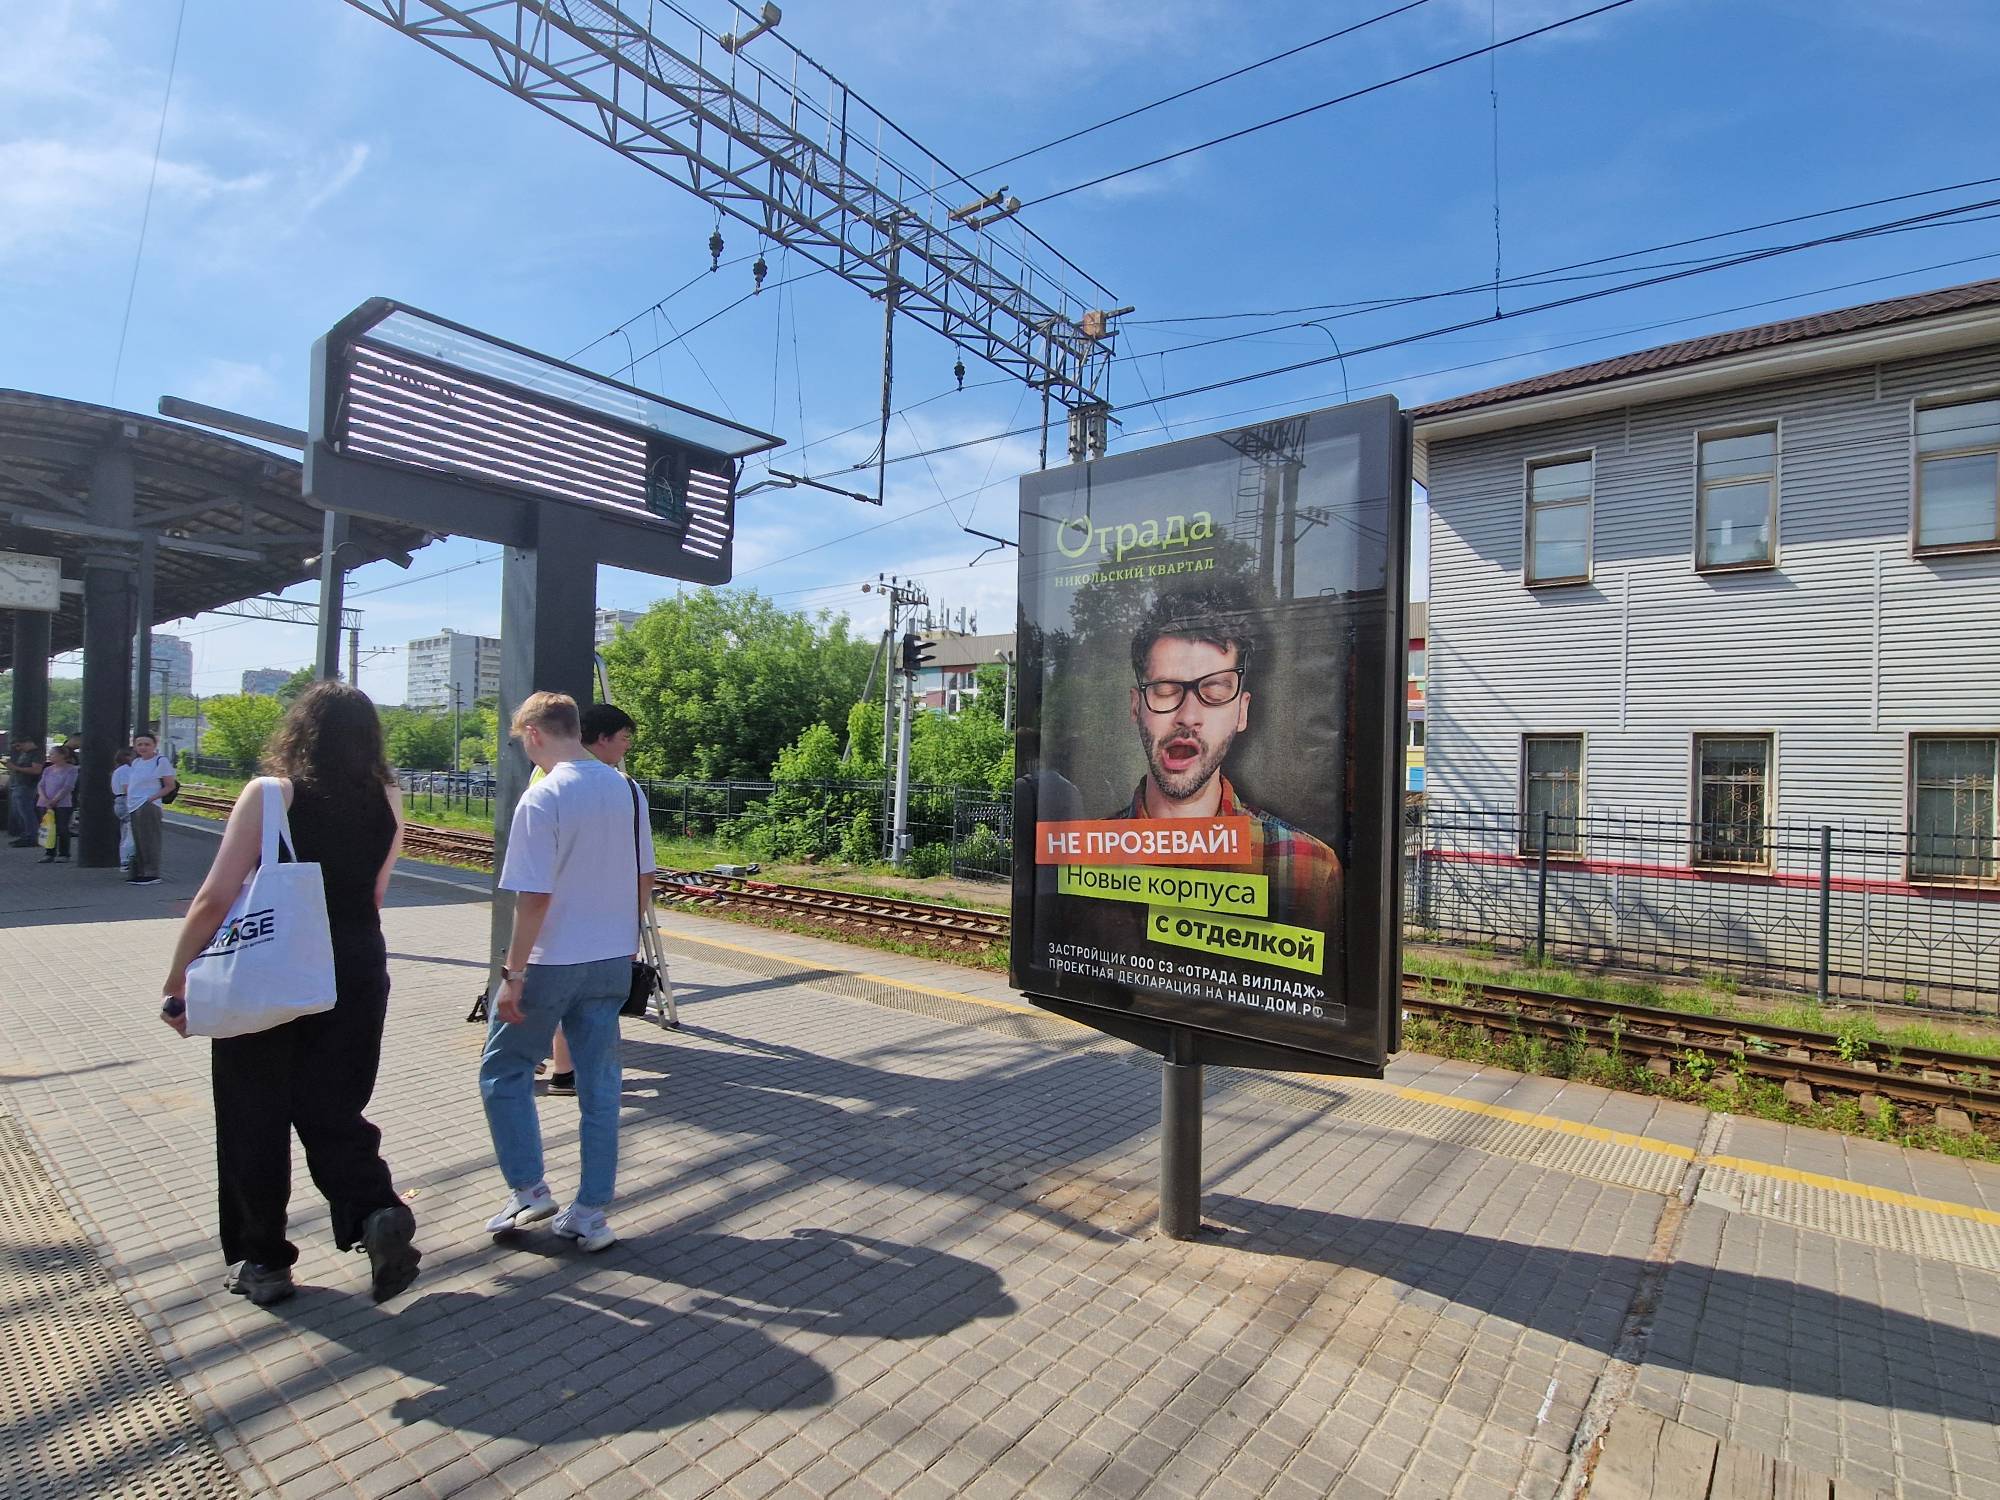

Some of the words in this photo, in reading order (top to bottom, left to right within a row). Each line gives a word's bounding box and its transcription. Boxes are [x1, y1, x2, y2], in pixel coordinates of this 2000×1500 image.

[1056, 511, 1214, 562] Отрада
[1055, 565, 1144, 587] НИКОЛЬСКИЙ
[1148, 558, 1214, 577] КВАРТАЛ
[1047, 832, 1081, 855] НЕ
[1087, 824, 1238, 854] ПРОЗЕВАЙ!
[1066, 864, 1142, 892] Новые
[1148, 876, 1255, 906] корпуса
[1155, 916, 1169, 933] с
[1176, 918, 1315, 962] отделкой
[1048, 941, 1127, 967] ЗАСТРОЙЩИК
[1130, 955, 1154, 970] ООО
[1158, 960, 1174, 973] СЗ
[1177, 963, 1238, 986] «ОТРАДА
[1242, 974, 1325, 1000] ВИЛЛАДЖ»
[1048, 957, 1115, 980] ПРОЕКТНАЯ
[1118, 971, 1201, 999] ДЕКЛАРАЦИЯ
[1206, 984, 1223, 999] НА
[1227, 989, 1324, 1019] НАШ.ДОМ.РФ
